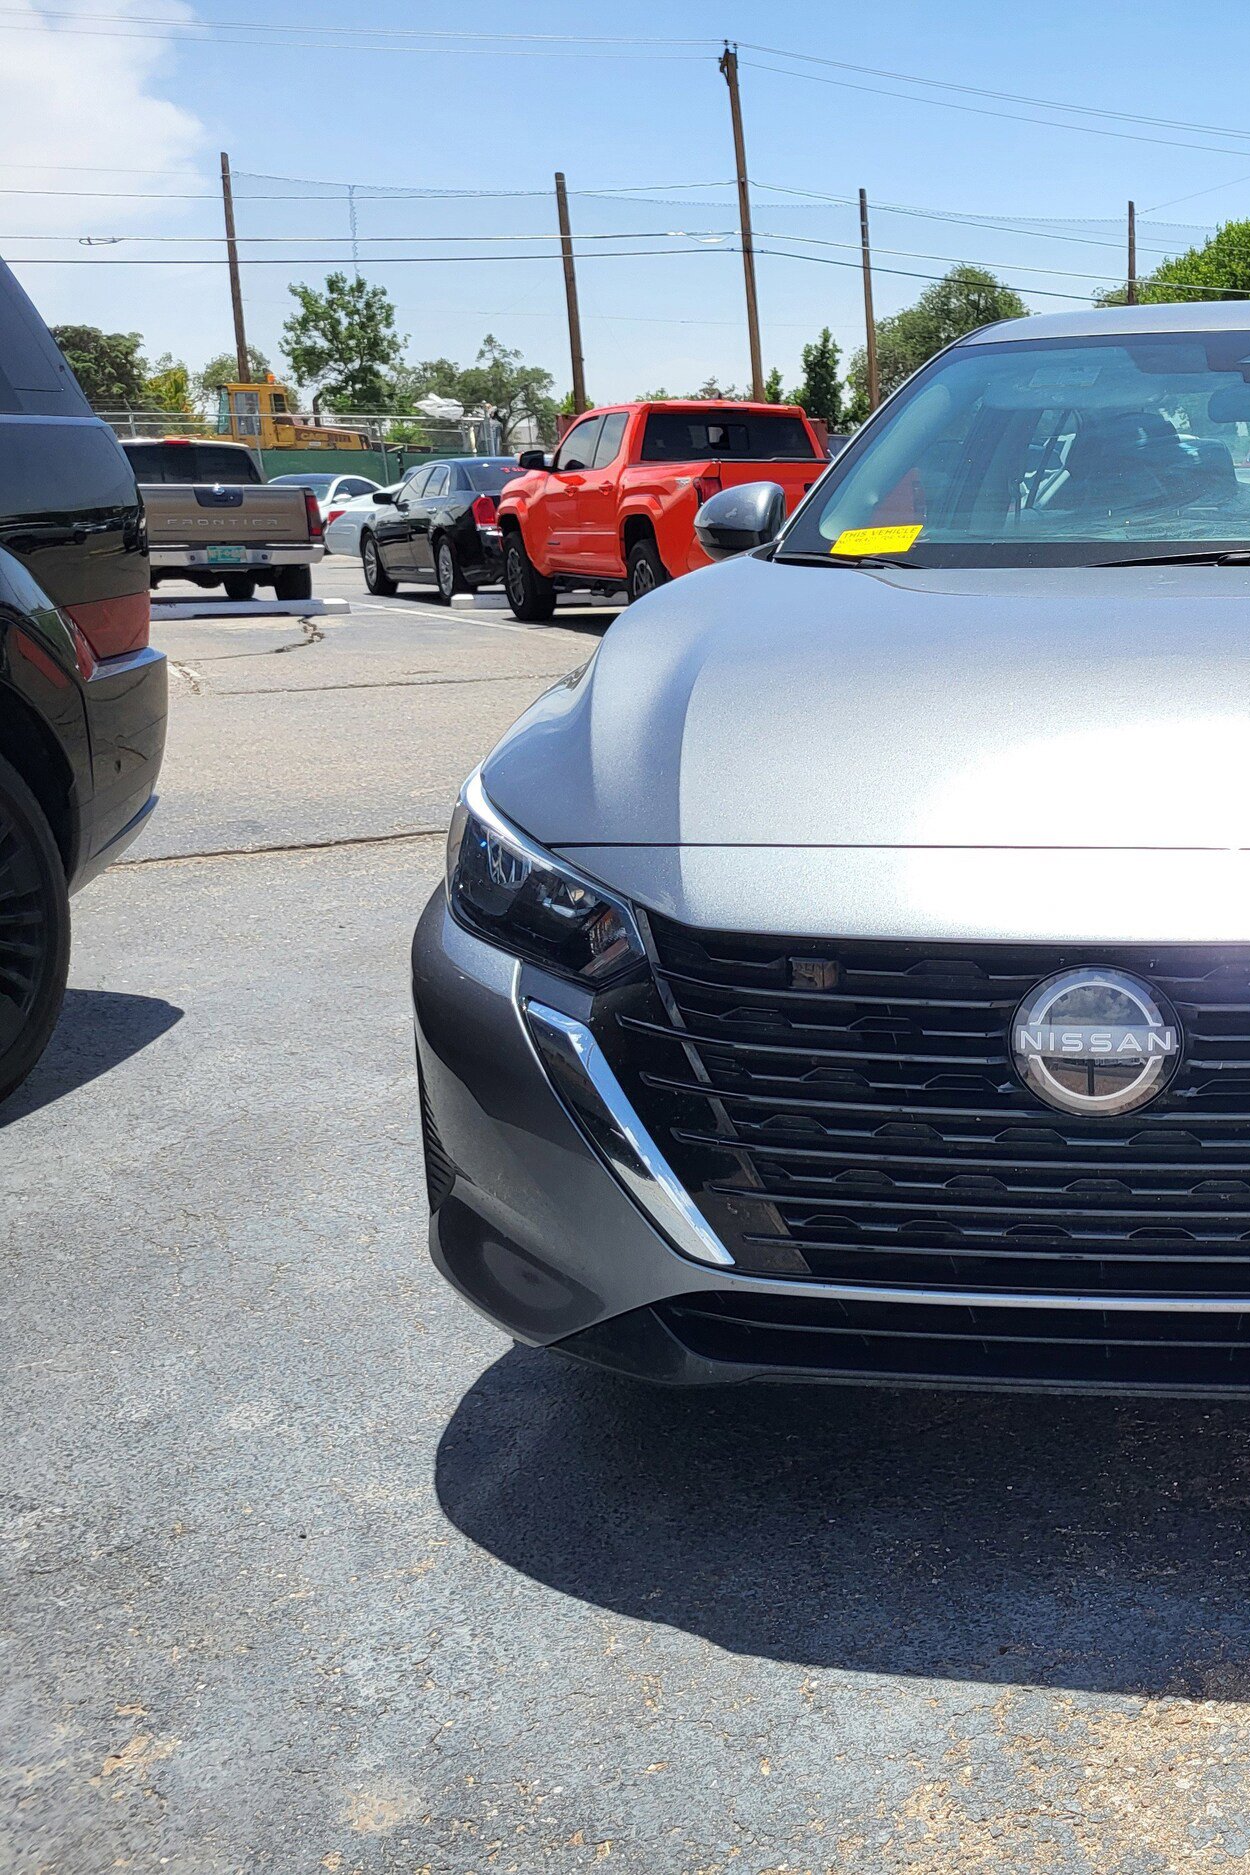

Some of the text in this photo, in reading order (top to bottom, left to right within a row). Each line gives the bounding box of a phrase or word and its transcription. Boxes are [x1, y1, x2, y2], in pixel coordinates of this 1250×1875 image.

[844, 527, 918, 538] THIS VEHICLE
[1020, 1030, 1171, 1052] NISSAN
